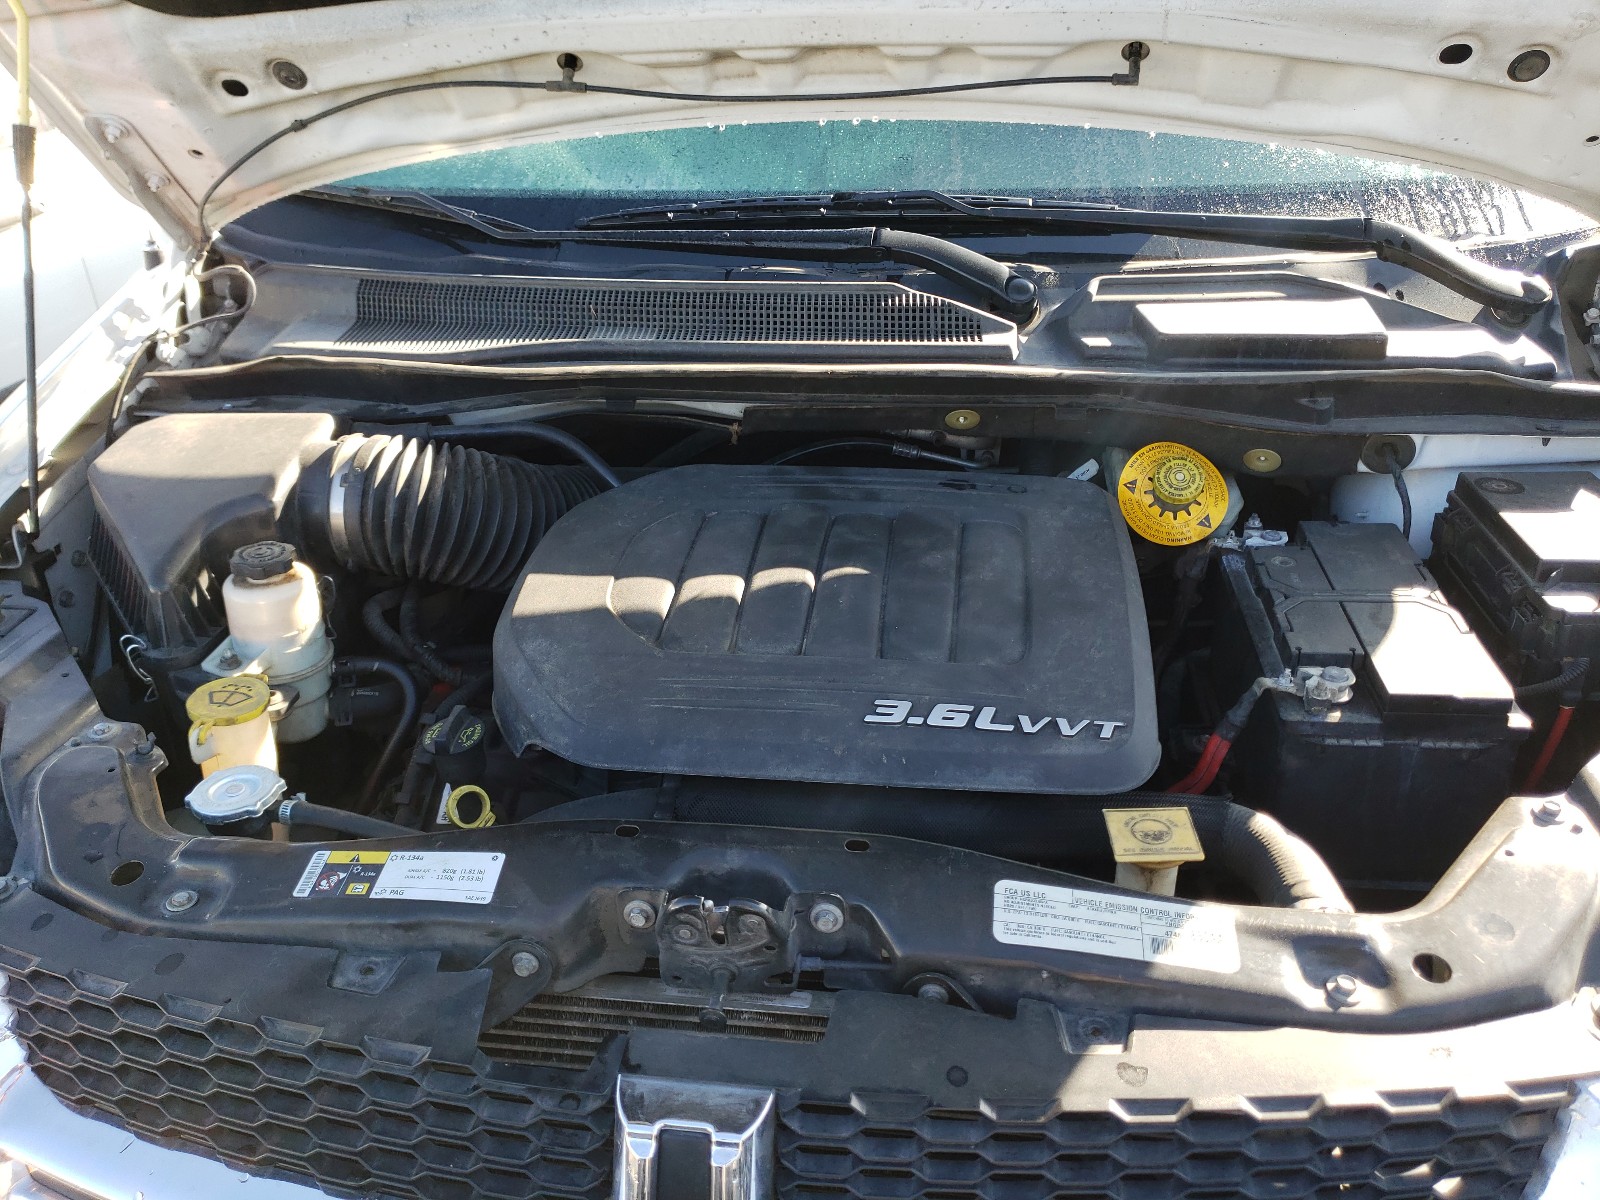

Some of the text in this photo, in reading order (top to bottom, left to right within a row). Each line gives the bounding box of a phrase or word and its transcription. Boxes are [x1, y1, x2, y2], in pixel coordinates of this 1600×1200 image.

[1074, 897, 1102, 907] VEHICLE
[1105, 902, 1138, 912] EMISSION
[1140, 906, 1172, 916] CONTROL
